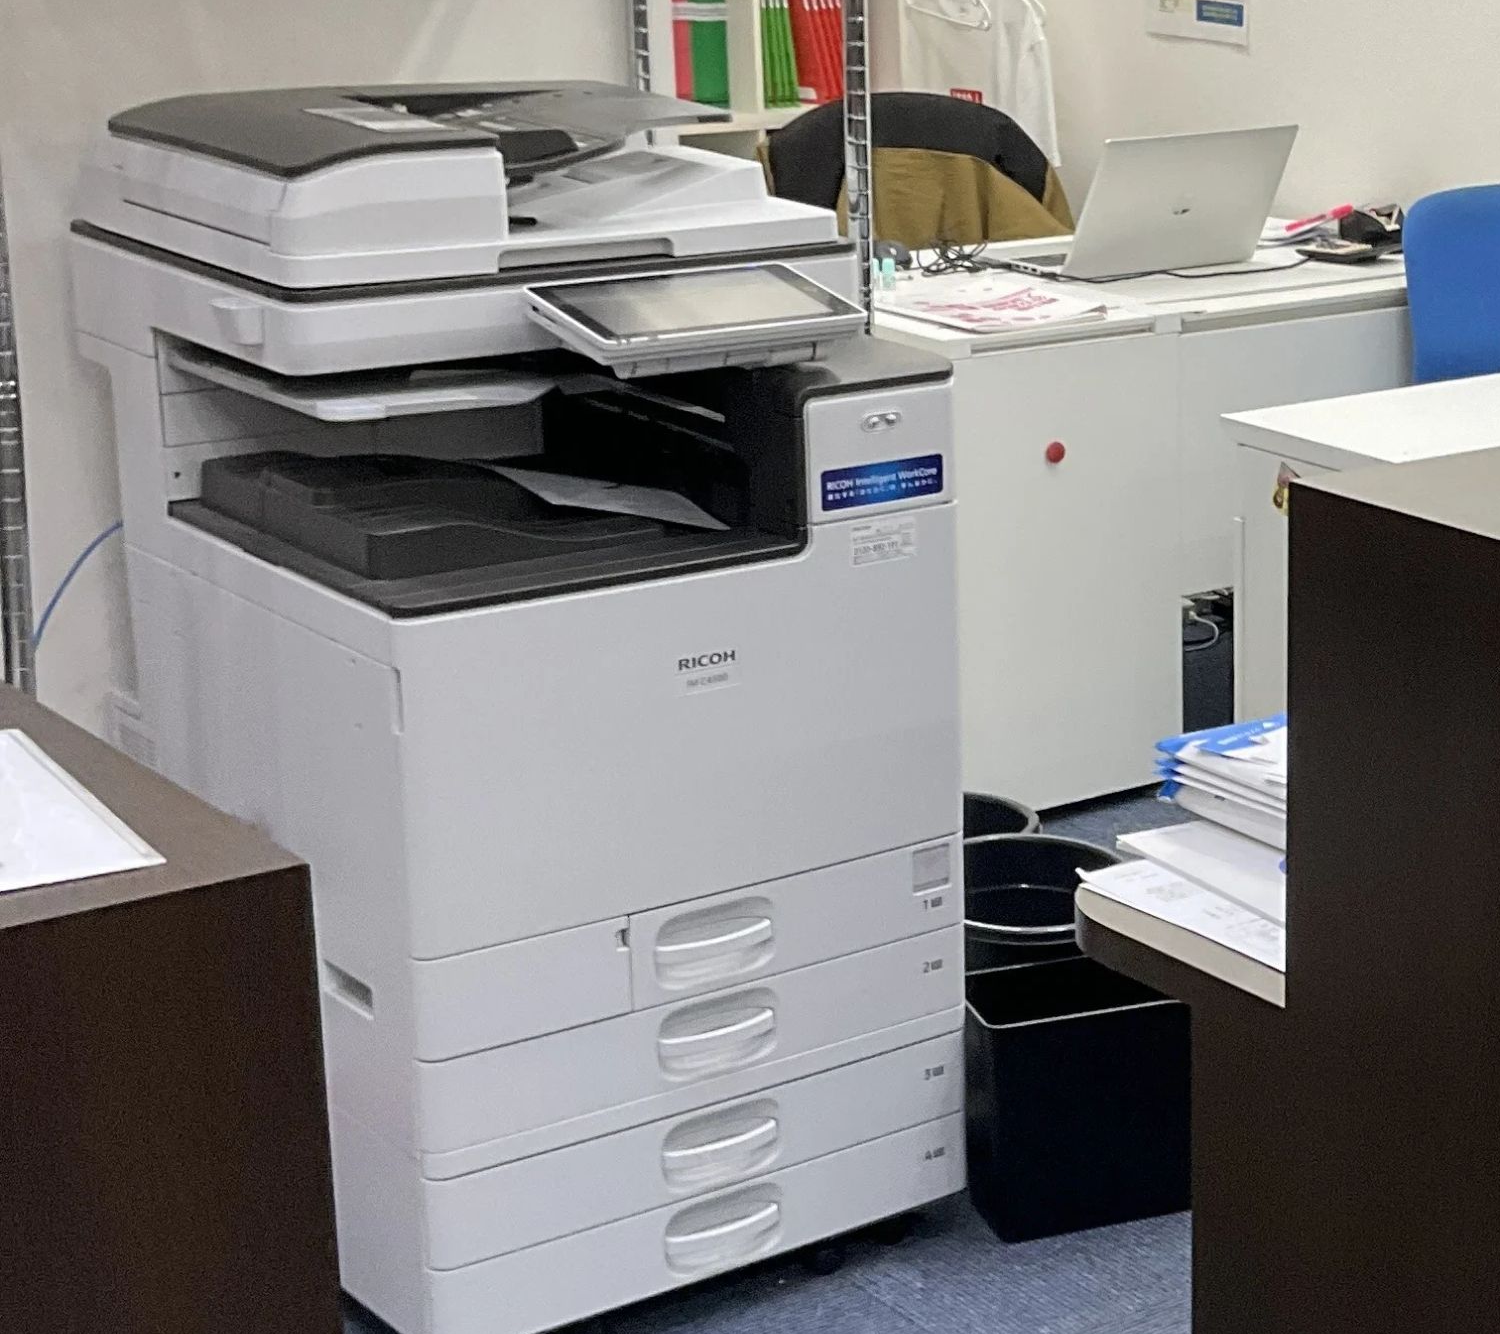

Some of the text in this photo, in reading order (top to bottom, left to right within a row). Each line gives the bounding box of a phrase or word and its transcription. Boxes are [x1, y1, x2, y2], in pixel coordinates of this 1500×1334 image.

[826, 479, 854, 491] RICOH
[855, 472, 897, 486] Intelligent
[677, 649, 736, 672] RICOH
